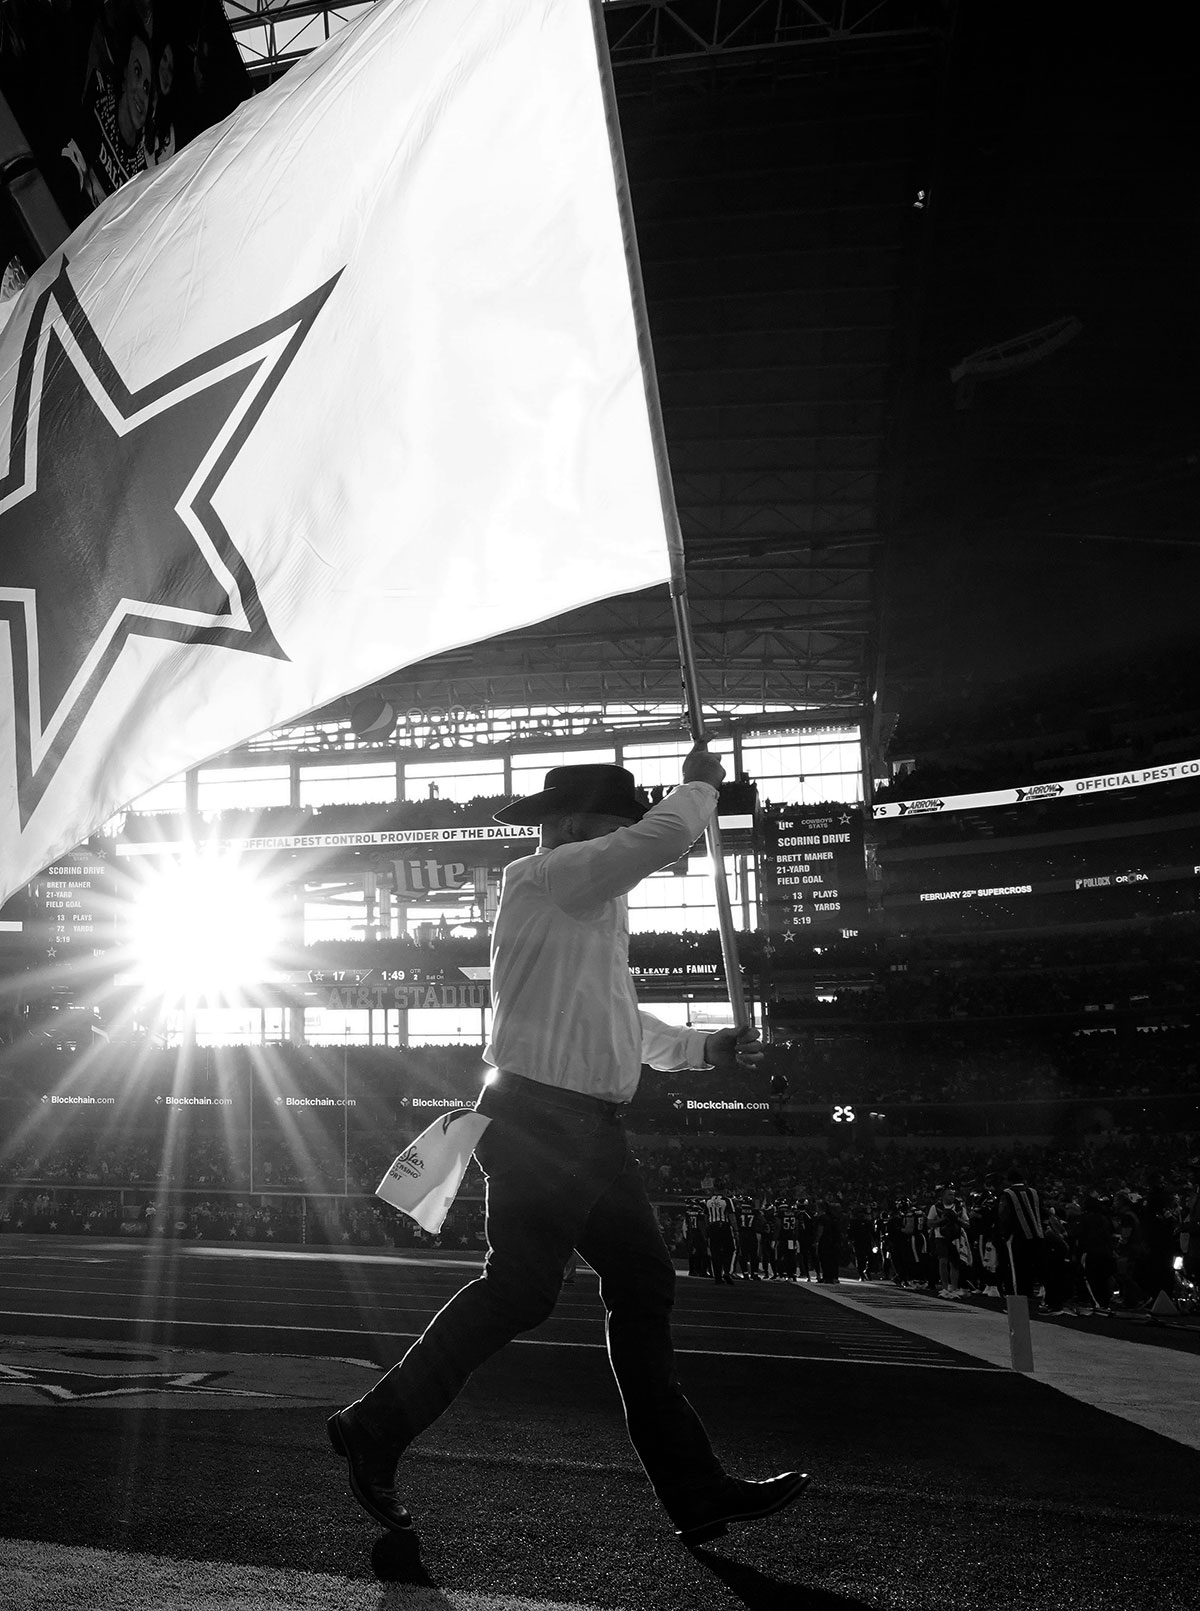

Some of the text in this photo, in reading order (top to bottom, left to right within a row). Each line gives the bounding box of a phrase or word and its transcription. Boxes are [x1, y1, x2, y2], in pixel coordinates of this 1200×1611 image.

[1076, 774, 1139, 791] OFFICIAL
[1143, 766, 1177, 782] PEST
[778, 820, 794, 830] Lite
[293, 836, 322, 847] PEST
[325, 834, 378, 845] CONTROL
[380, 831, 439, 843] PROVIDER
[442, 830, 458, 840] OF
[461, 829, 484, 838] THE
[487, 827, 534, 838] DALLAS
[777, 833, 851, 847] SCORING DRIVE
[776, 852, 834, 863] BRETT MAHER
[48, 866, 105, 875] SCORING DRIVE
[776, 865, 810, 874] 21-YARD
[46, 881, 91, 889] BRETT MAHER
[777, 875, 824, 885] FIELD GOAL
[1083, 876, 1111, 888] POLLOCK
[792, 890, 838, 900] 13 PLAYS
[920, 891, 961, 901] FEBRUARY
[977, 885, 1032, 897] SUPERCROSS
[814, 903, 841, 911] YARDS
[793, 917, 812, 925] 5:19
[842, 928, 859, 939] Lite
[686, 964, 718, 973] FAMILY
[332, 971, 345, 981] 17
[381, 971, 405, 981] 1:49
[327, 986, 388, 1009] AT&T
[51, 1095, 115, 1105] Blockchain.com
[165, 1095, 233, 1105] Blockchain.com
[285, 1097, 356, 1107] Blockchain.com
[412, 1098, 478, 1107] Blockchain.co
[686, 1099, 769, 1110] Blockchain.com
[832, 1105, 855, 1122] 25
[395, 1162, 419, 1179] CASINO
[740, 1214, 755, 1228] 17
[783, 1216, 796, 1230] 53
